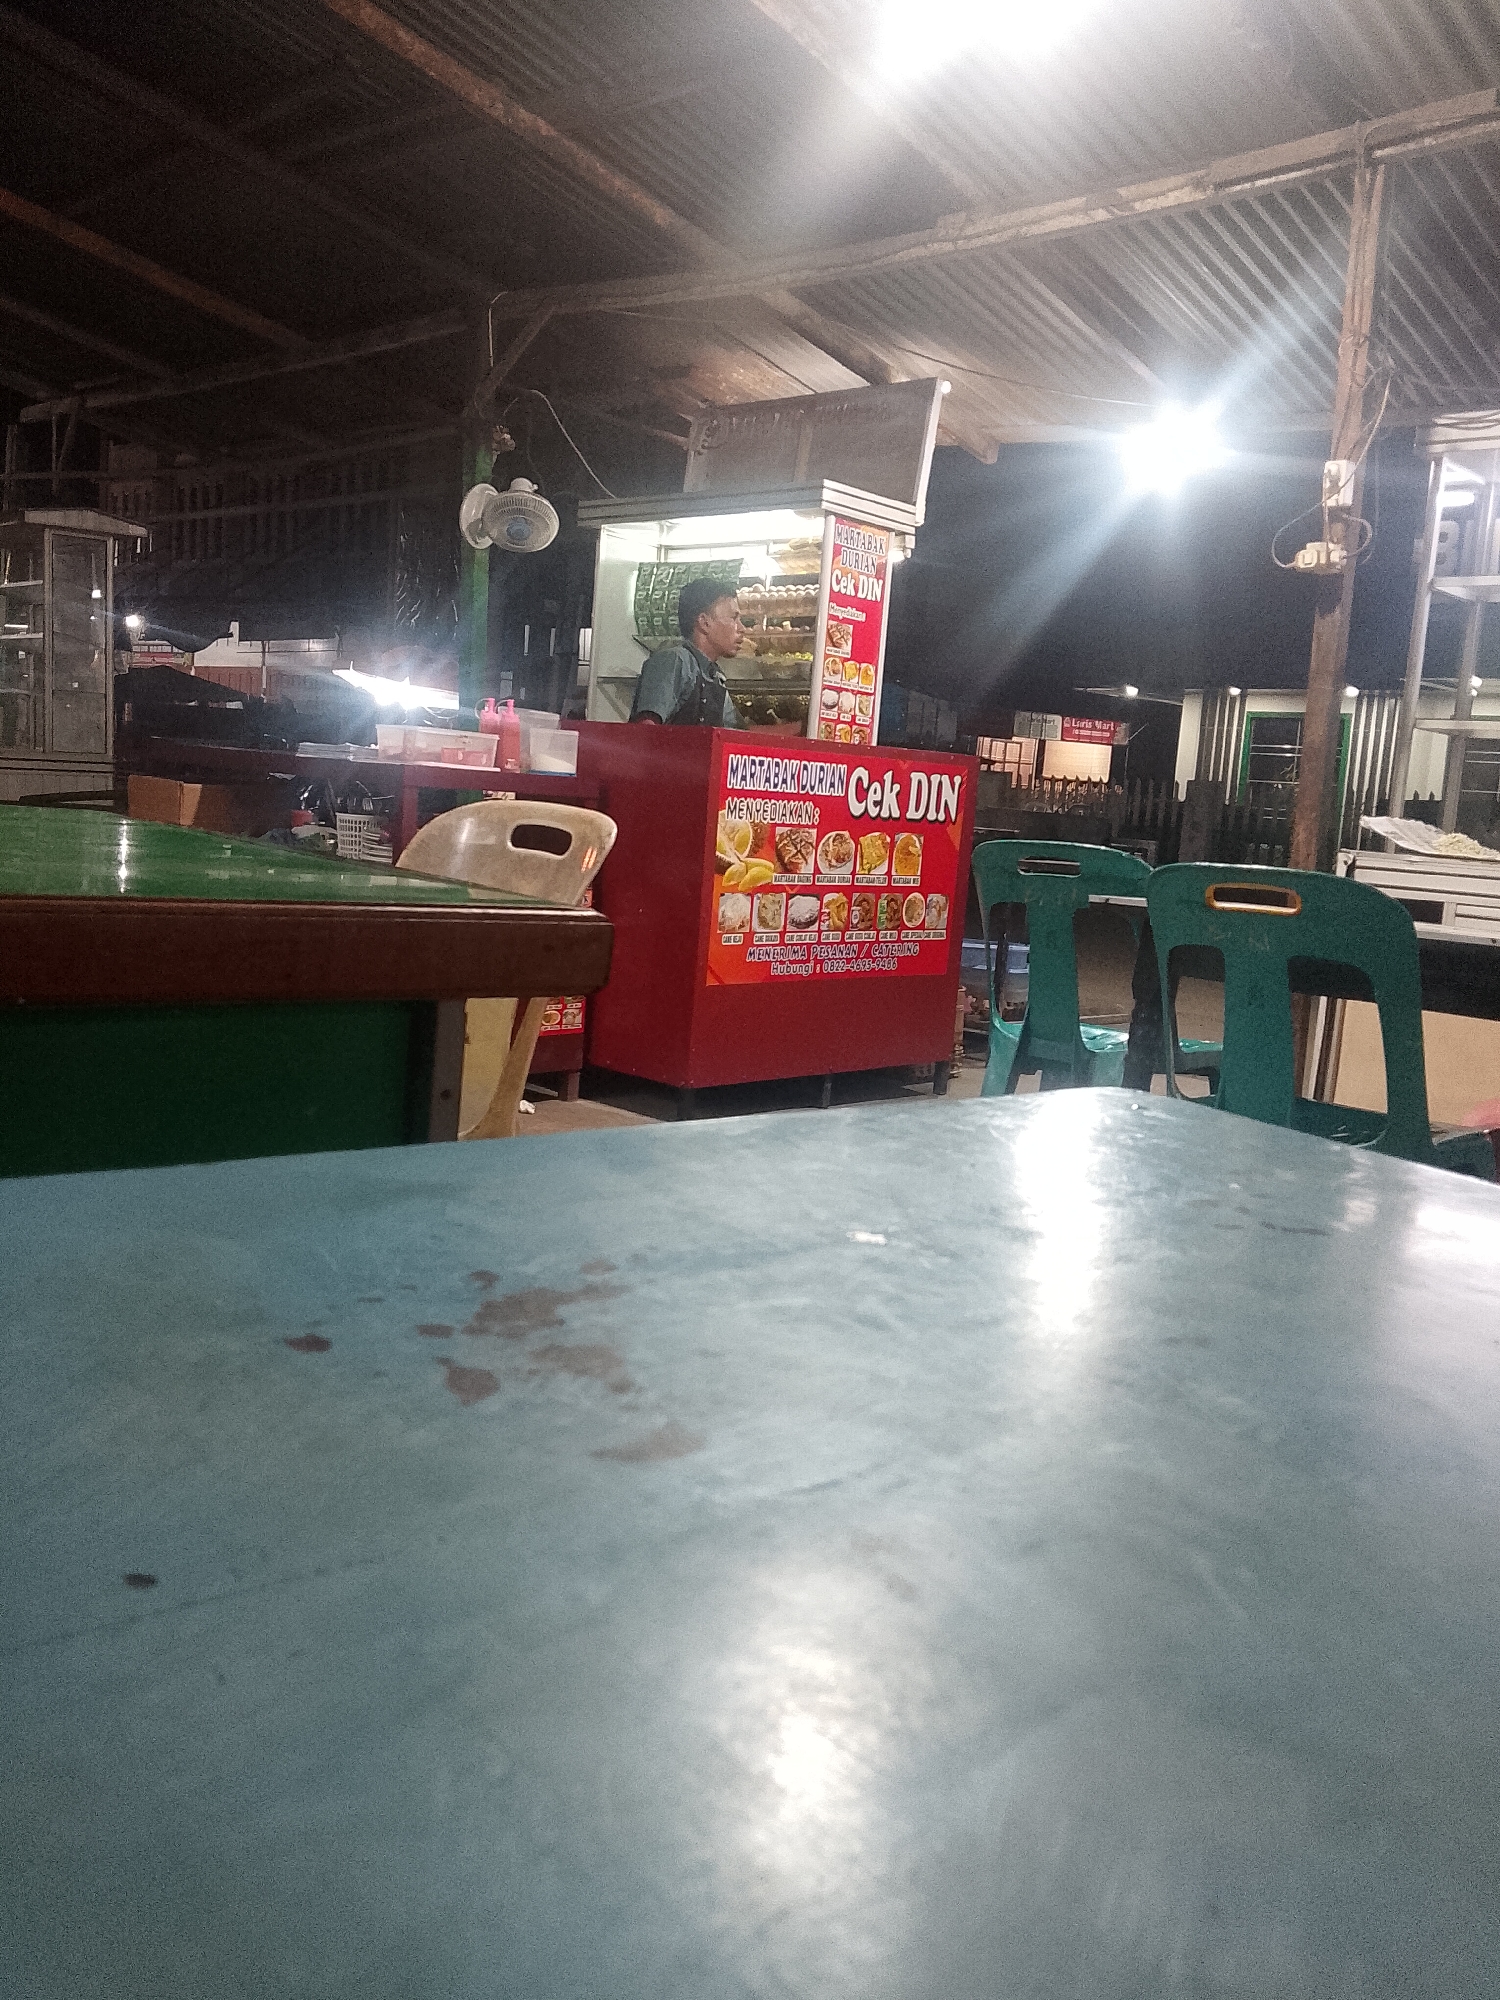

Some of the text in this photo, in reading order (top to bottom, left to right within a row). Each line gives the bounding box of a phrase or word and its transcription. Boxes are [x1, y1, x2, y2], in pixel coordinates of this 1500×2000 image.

[835, 524, 886, 556] MARTABAK
[841, 547, 877, 575] DURIAN
[832, 569, 883, 602] Cek DIN
[1072, 718, 1114, 730] Laris Mart
[727, 754, 962, 823] MARTABAK DURIAN Cek DIN
[747, 944, 806, 962] MENERIMA
[810, 943, 858, 959] PESANAN
[871, 942, 919, 957] CATERING
[771, 961, 814, 976] Hubungi
[823, 959, 897, 974] 0822-4695-9486
